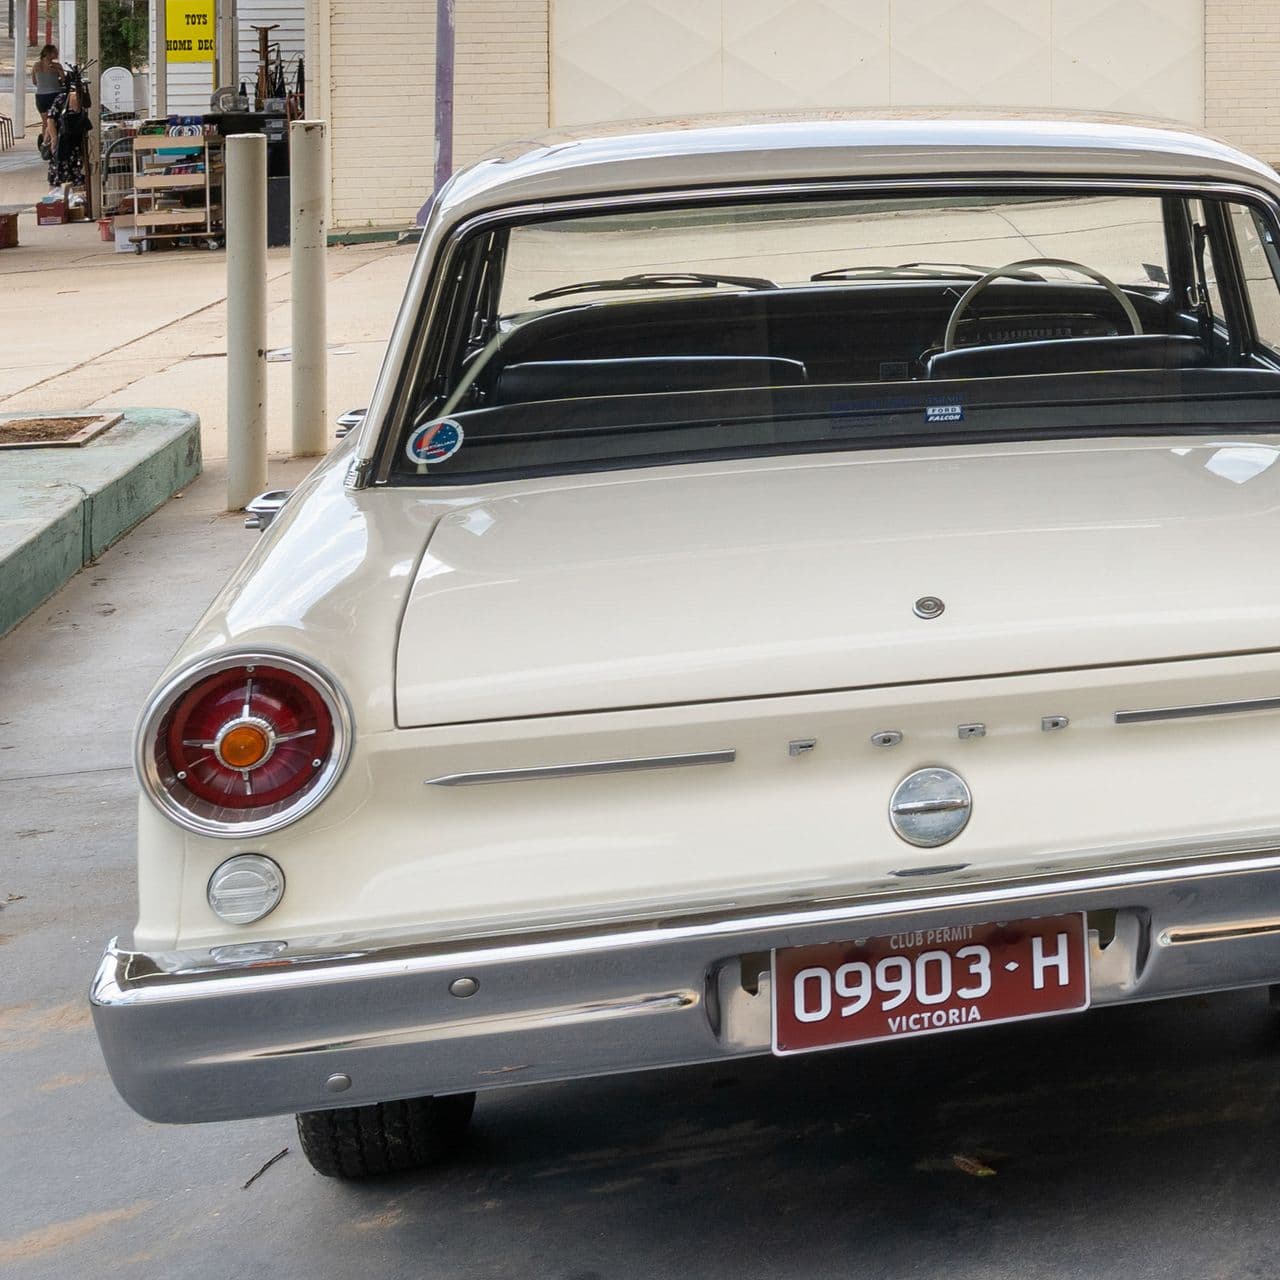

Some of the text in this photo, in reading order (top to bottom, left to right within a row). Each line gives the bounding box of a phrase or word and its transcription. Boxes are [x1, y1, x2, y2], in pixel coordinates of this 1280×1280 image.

[184, 14, 208, 25] TOYS
[166, 39, 193, 51] HOME
[788, 715, 1070, 757] FORD
[889, 926, 975, 950] CLUB PERMIT
[887, 1005, 981, 1034] VICTORIA
